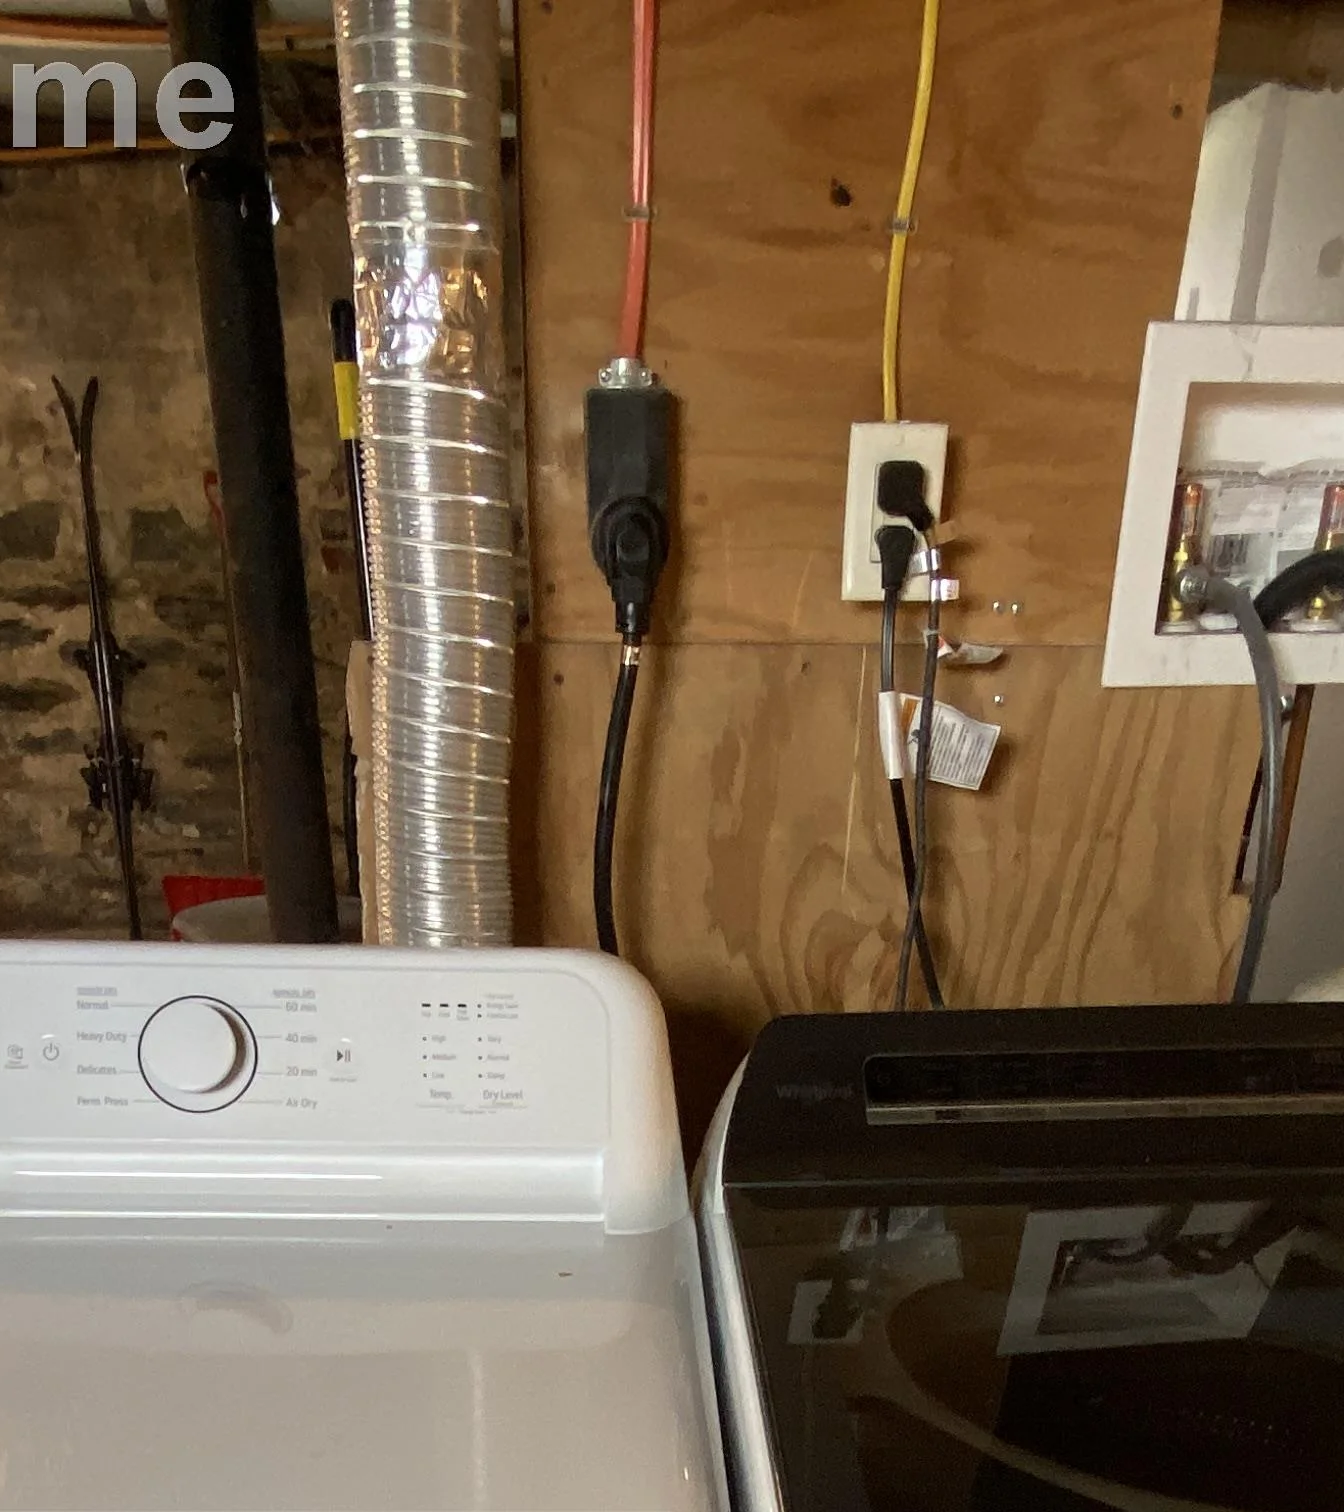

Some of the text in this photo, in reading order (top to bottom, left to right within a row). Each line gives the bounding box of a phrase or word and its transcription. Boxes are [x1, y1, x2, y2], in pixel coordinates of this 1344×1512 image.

[76, 1032, 127, 1043] Heavy Duty
[285, 1033, 298, 1043] 40
[286, 1066, 317, 1077] 20 min
[482, 1089, 524, 1101] Dry Level
